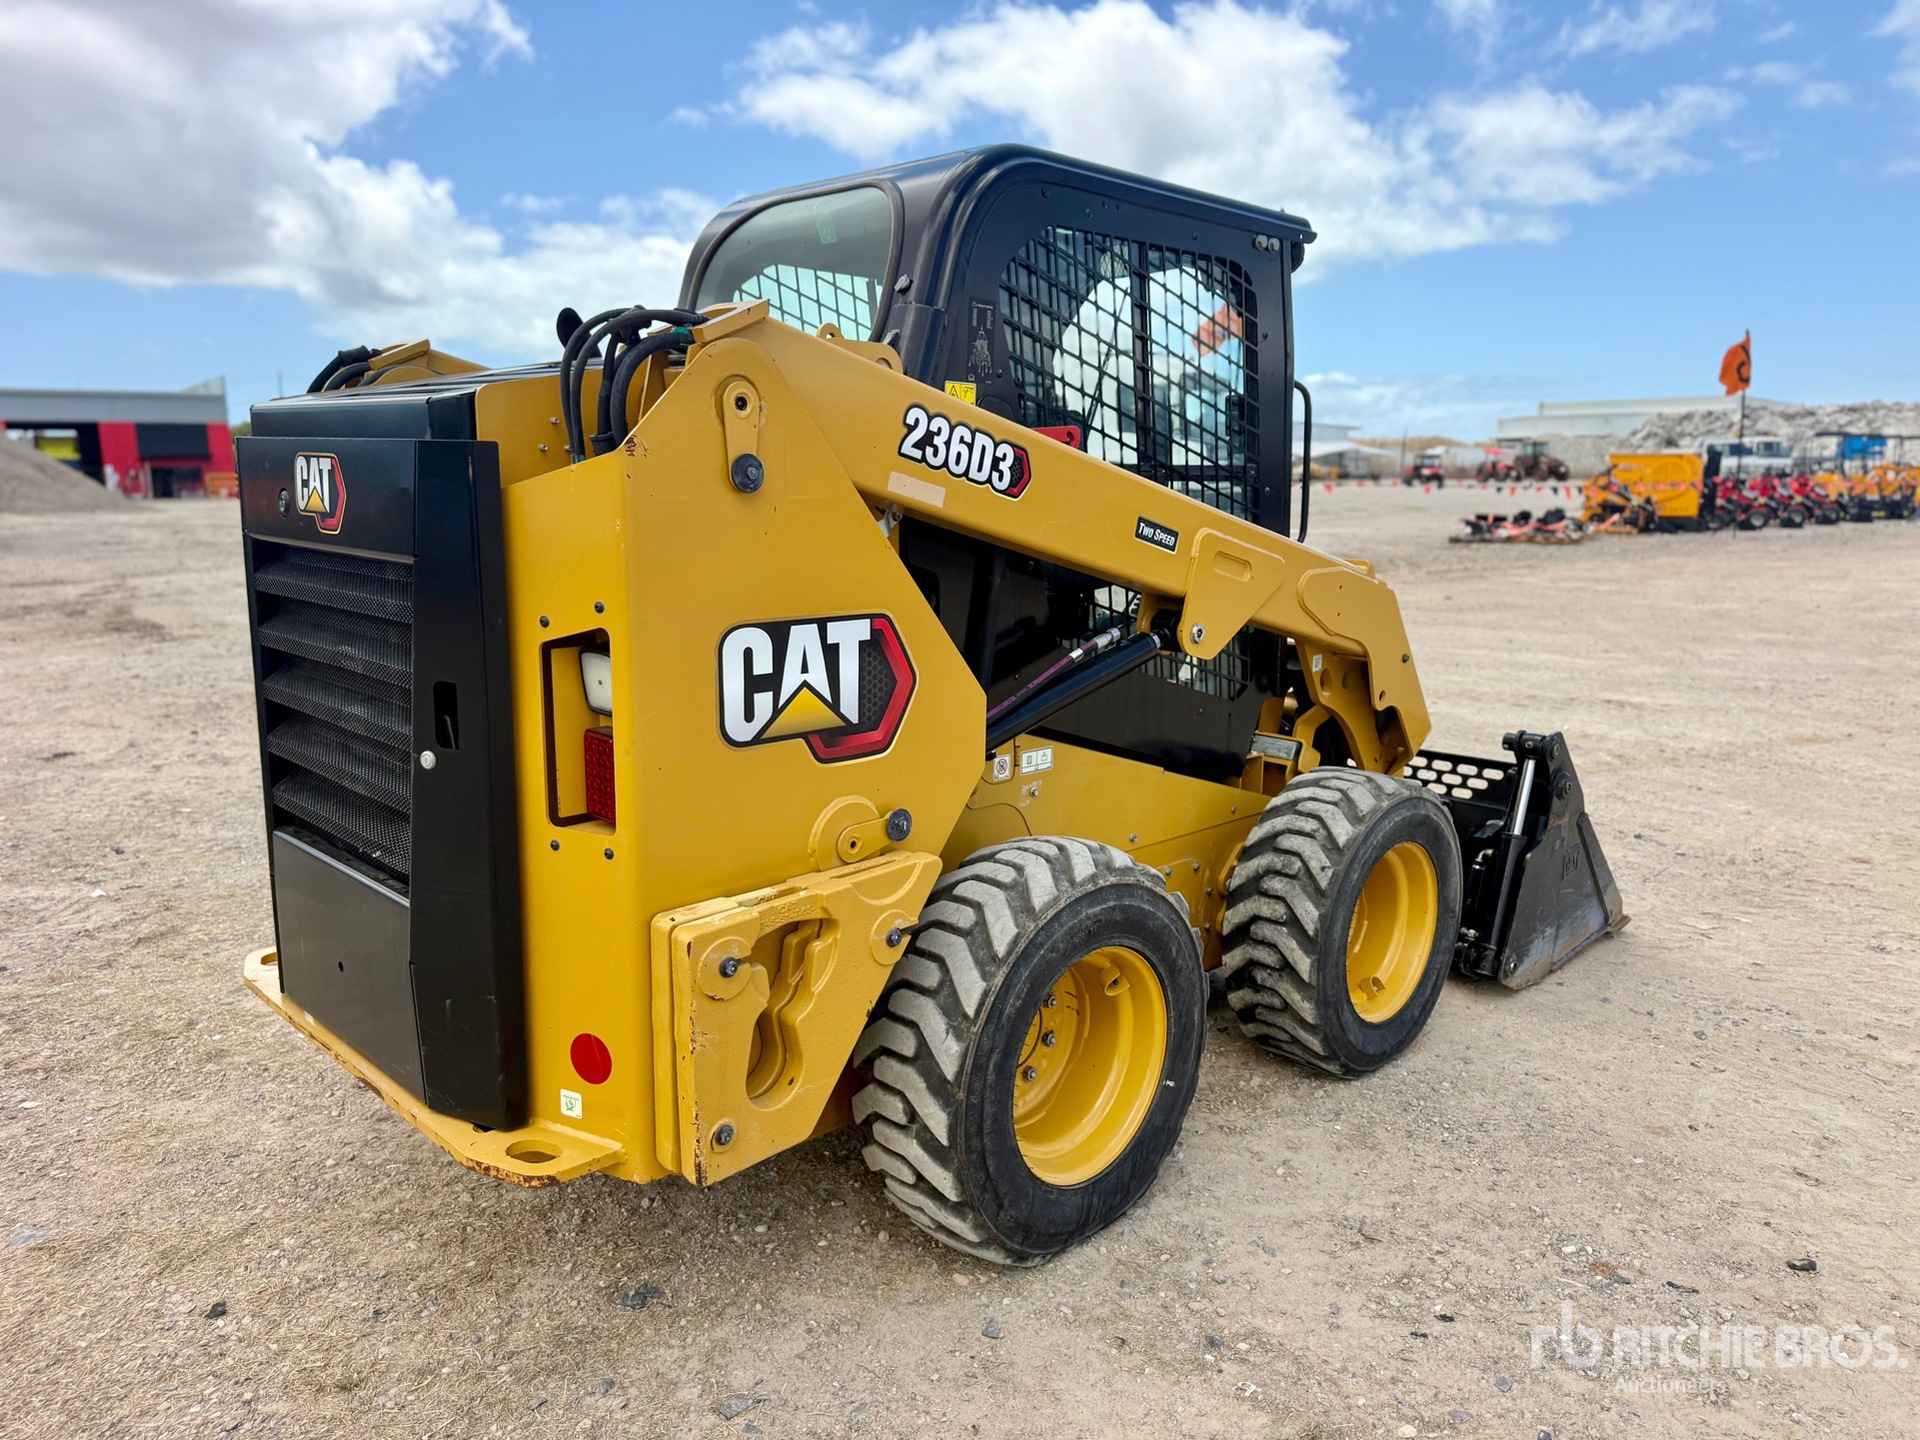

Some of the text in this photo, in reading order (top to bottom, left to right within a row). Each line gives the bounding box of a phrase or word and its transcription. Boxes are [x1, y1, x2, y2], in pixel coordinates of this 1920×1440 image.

[296, 455, 332, 513] CAT
[900, 406, 1015, 492] 236D3
[722, 618, 872, 743] CAT
